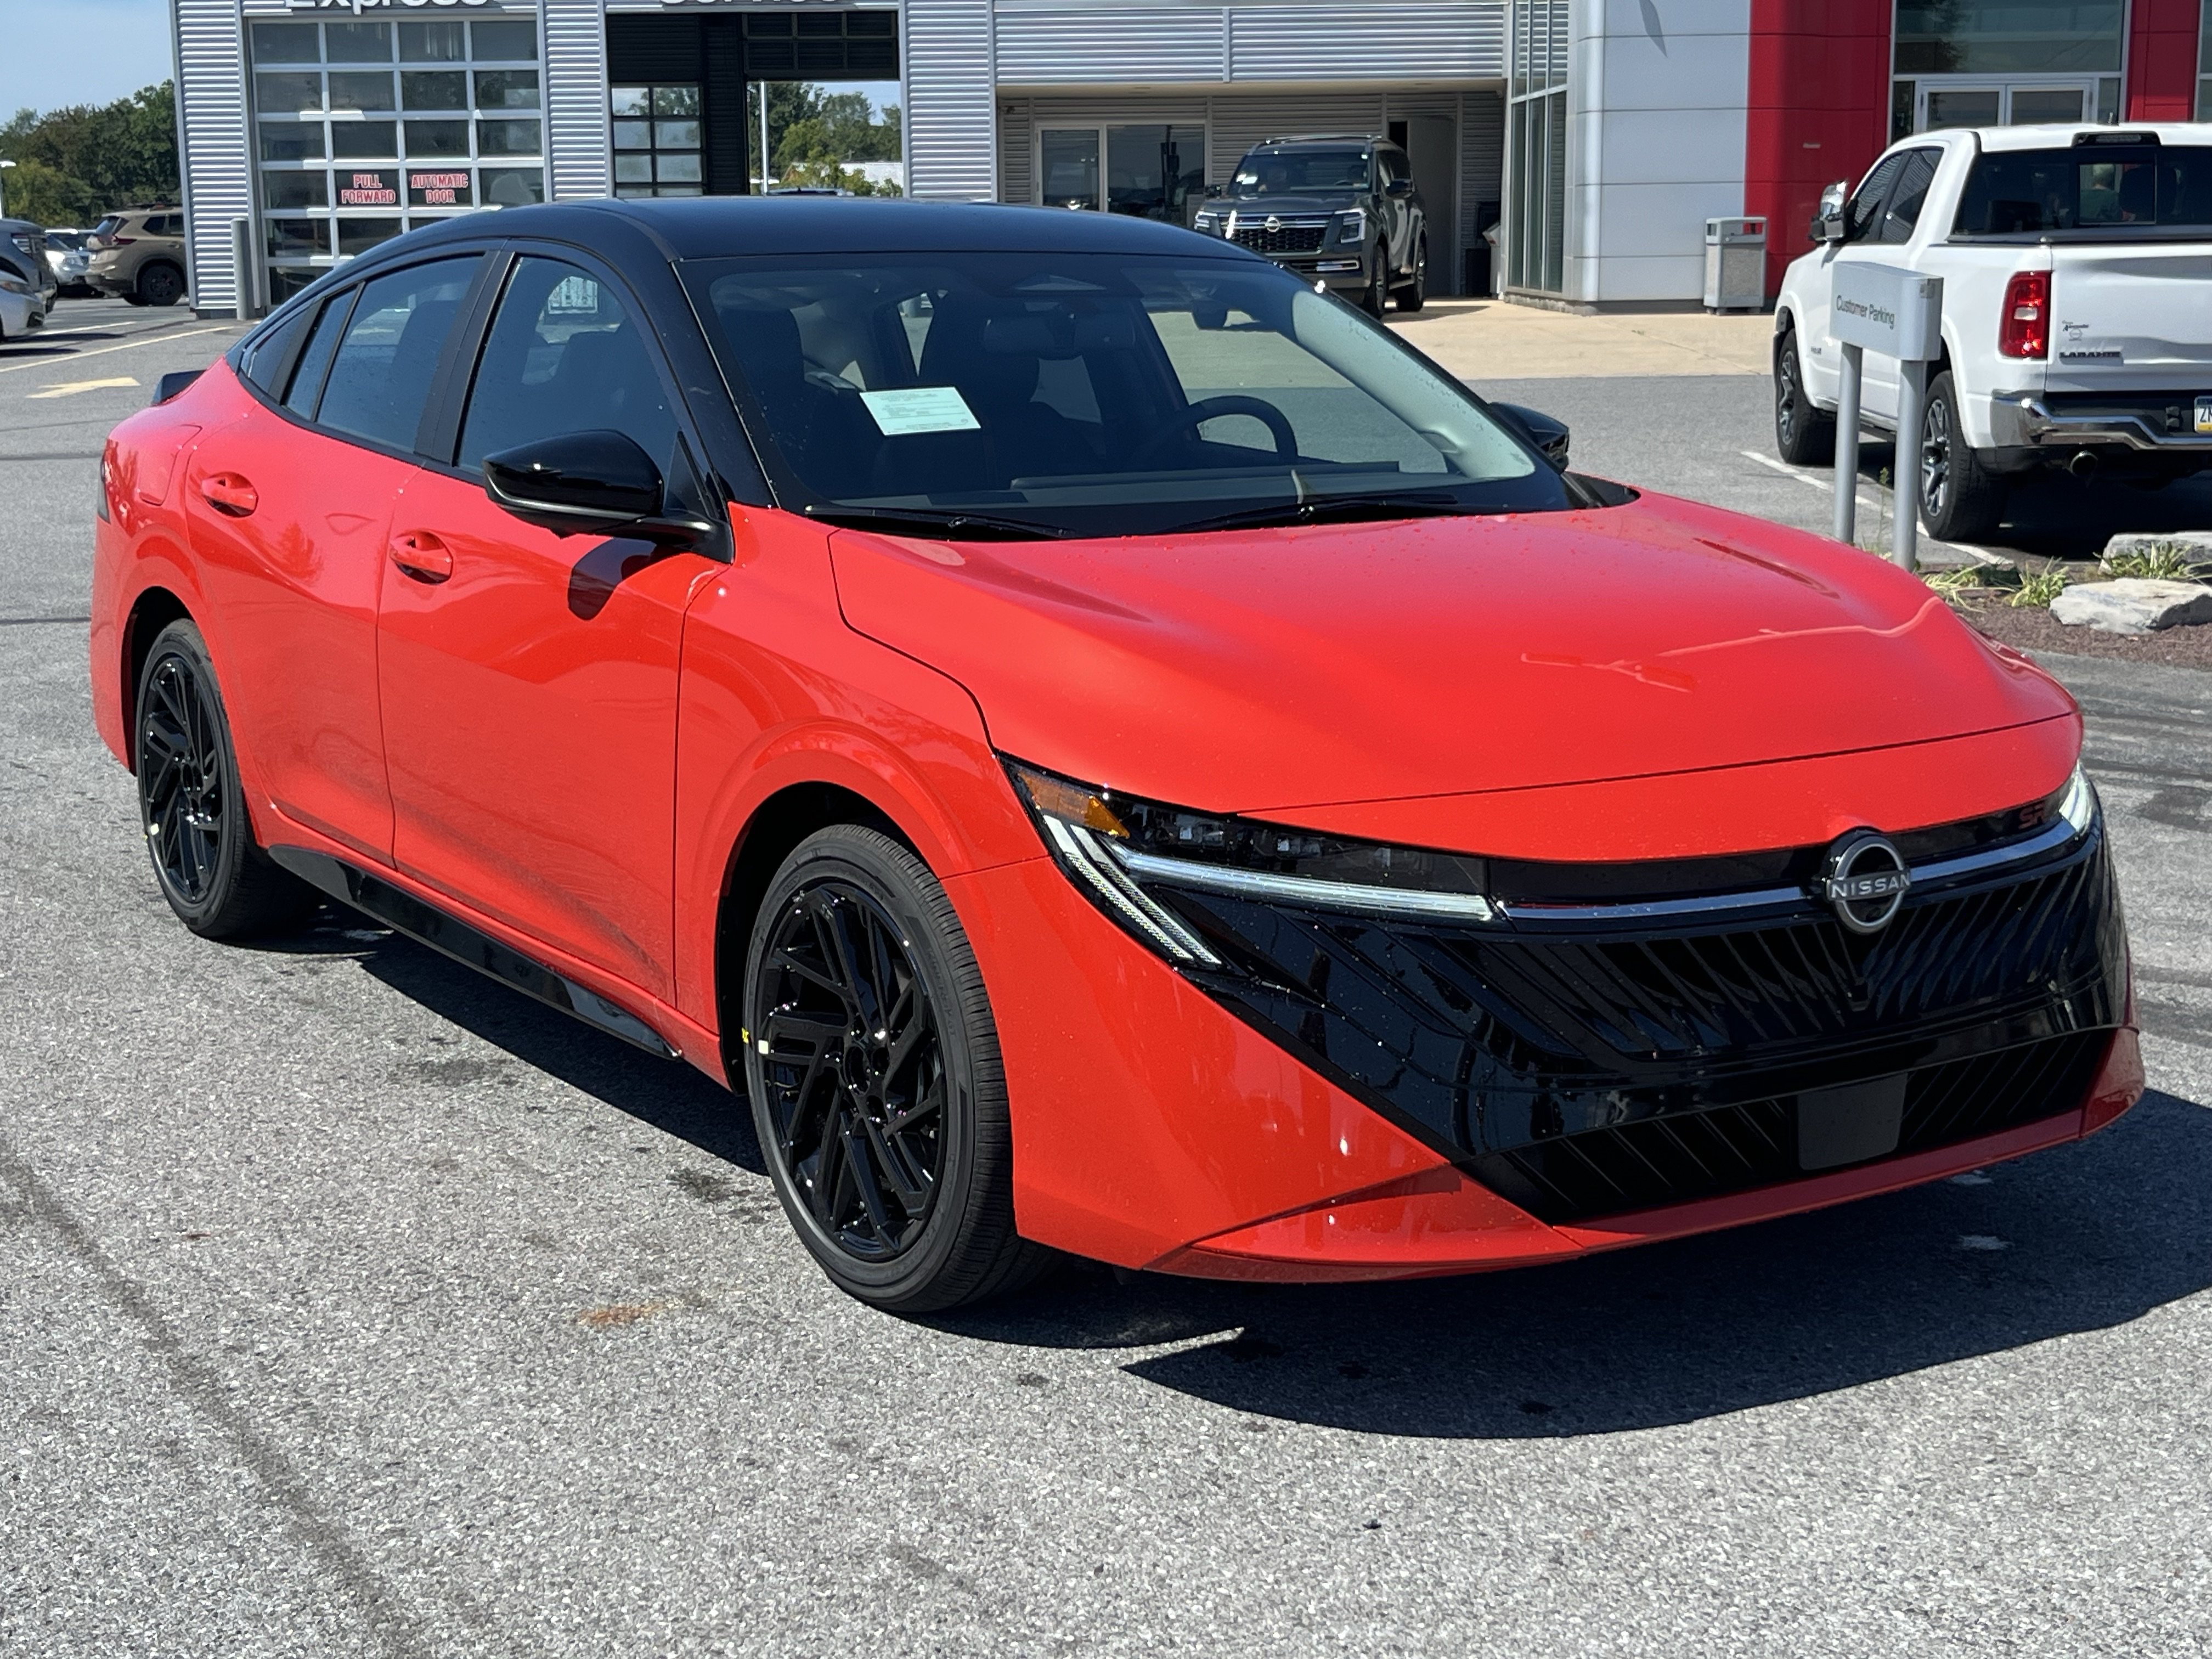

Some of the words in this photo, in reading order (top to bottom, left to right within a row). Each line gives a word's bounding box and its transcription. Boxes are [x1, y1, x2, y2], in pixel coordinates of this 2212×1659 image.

[353, 174, 382, 188] PULL
[411, 174, 469, 188] AUTOMATIC
[341, 190, 396, 204] FORWARD
[426, 190, 456, 204] DOOR
[1836, 295, 1867, 318] Customer
[1869, 303, 1894, 330] Parking
[1831, 872, 1910, 899] NISSAN
